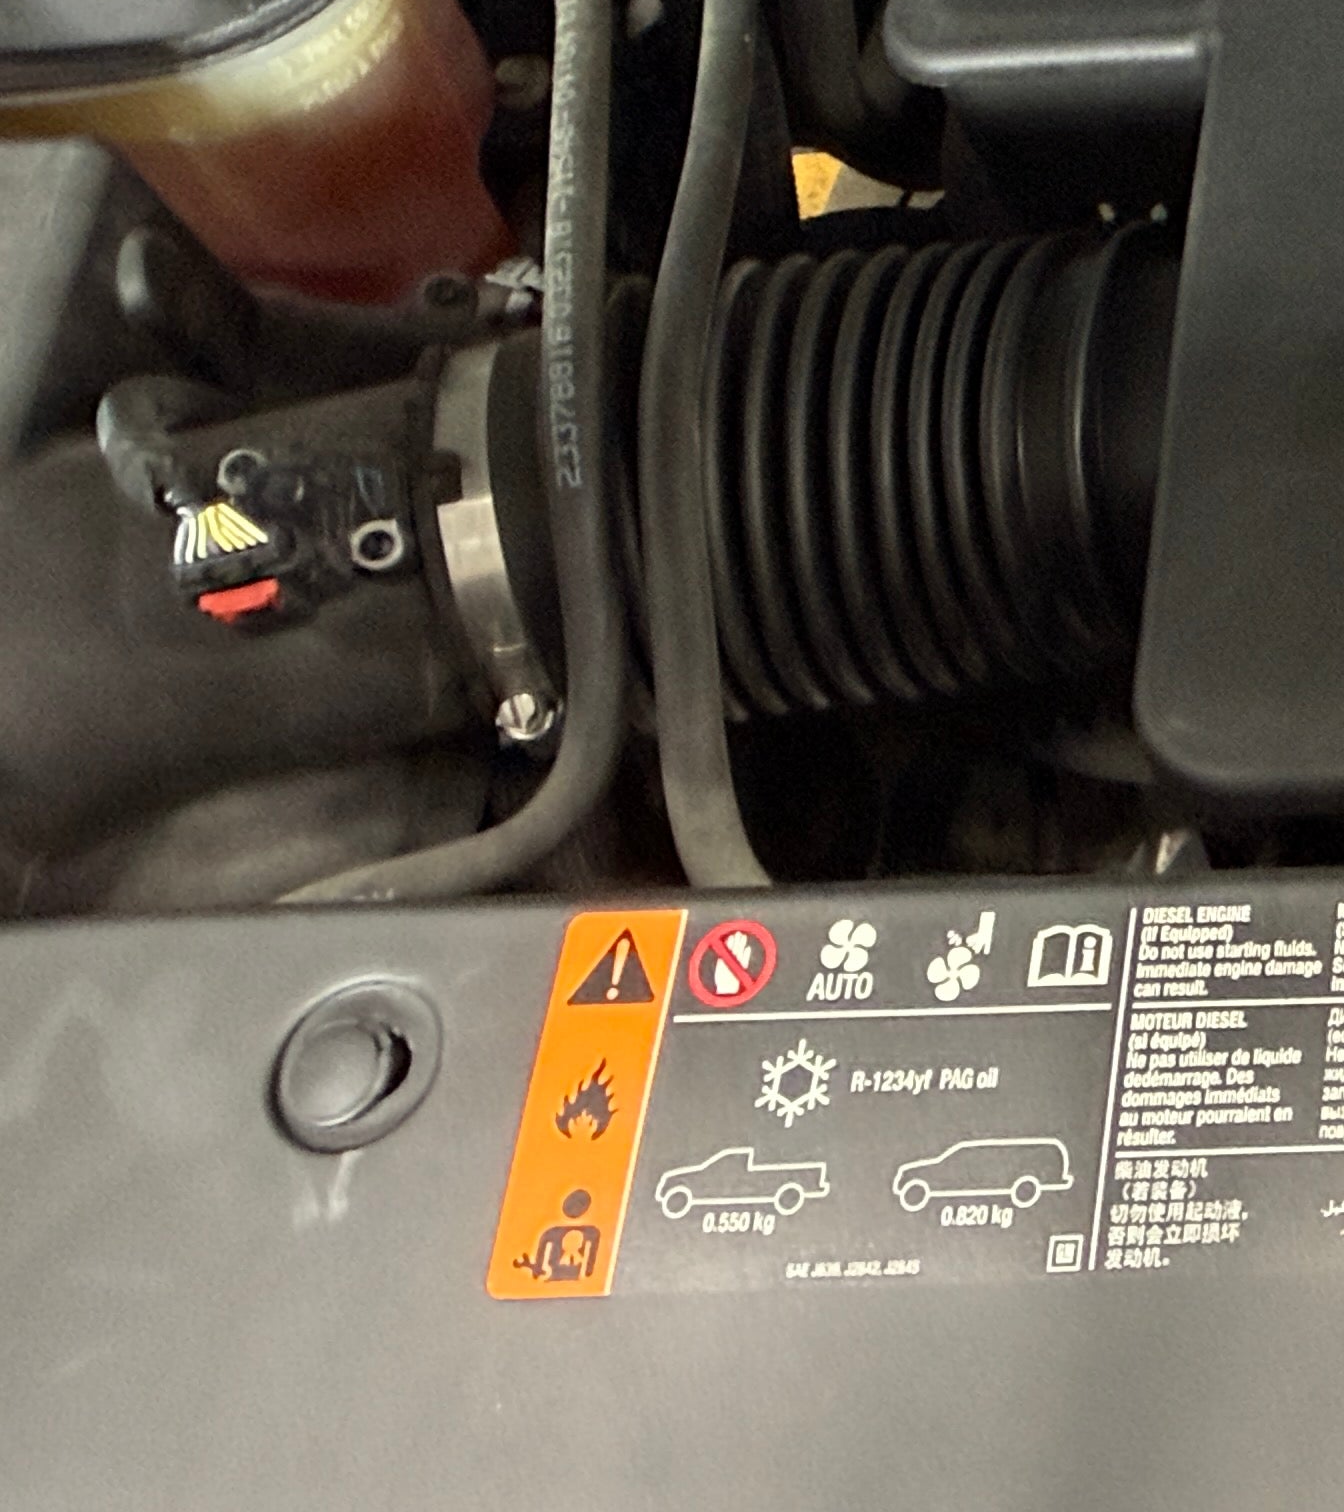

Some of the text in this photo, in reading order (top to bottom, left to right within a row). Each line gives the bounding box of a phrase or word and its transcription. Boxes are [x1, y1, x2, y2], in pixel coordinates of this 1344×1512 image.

[1143, 905, 1250, 924] DIESEL ENGINE
[1160, 924, 1233, 943] Equipped)
[1139, 940, 1317, 960] Do not use starting fluids.
[1214, 961, 1262, 979] engine
[1265, 960, 1322, 978] damage
[806, 971, 874, 1001] AUTO
[1134, 980, 1208, 997] can result.
[1130, 1011, 1248, 1031] MOTEUR DIESEL
[1150, 1031, 1206, 1051] équipé)
[1126, 1047, 1302, 1070] Ne pas utiliser de liquide
[939, 1067, 974, 1090] PAG
[977, 1066, 999, 1089] oil
[1226, 1068, 1255, 1085] Des
[1122, 1090, 1201, 1109] dommages
[1119, 1106, 1293, 1127] au moteur pourraient en
[1114, 1158, 1208, 1180] 柴油发动机
[702, 1212, 775, 1235] 0.550 kg
[940, 1205, 1014, 1229] 0.820 kg
